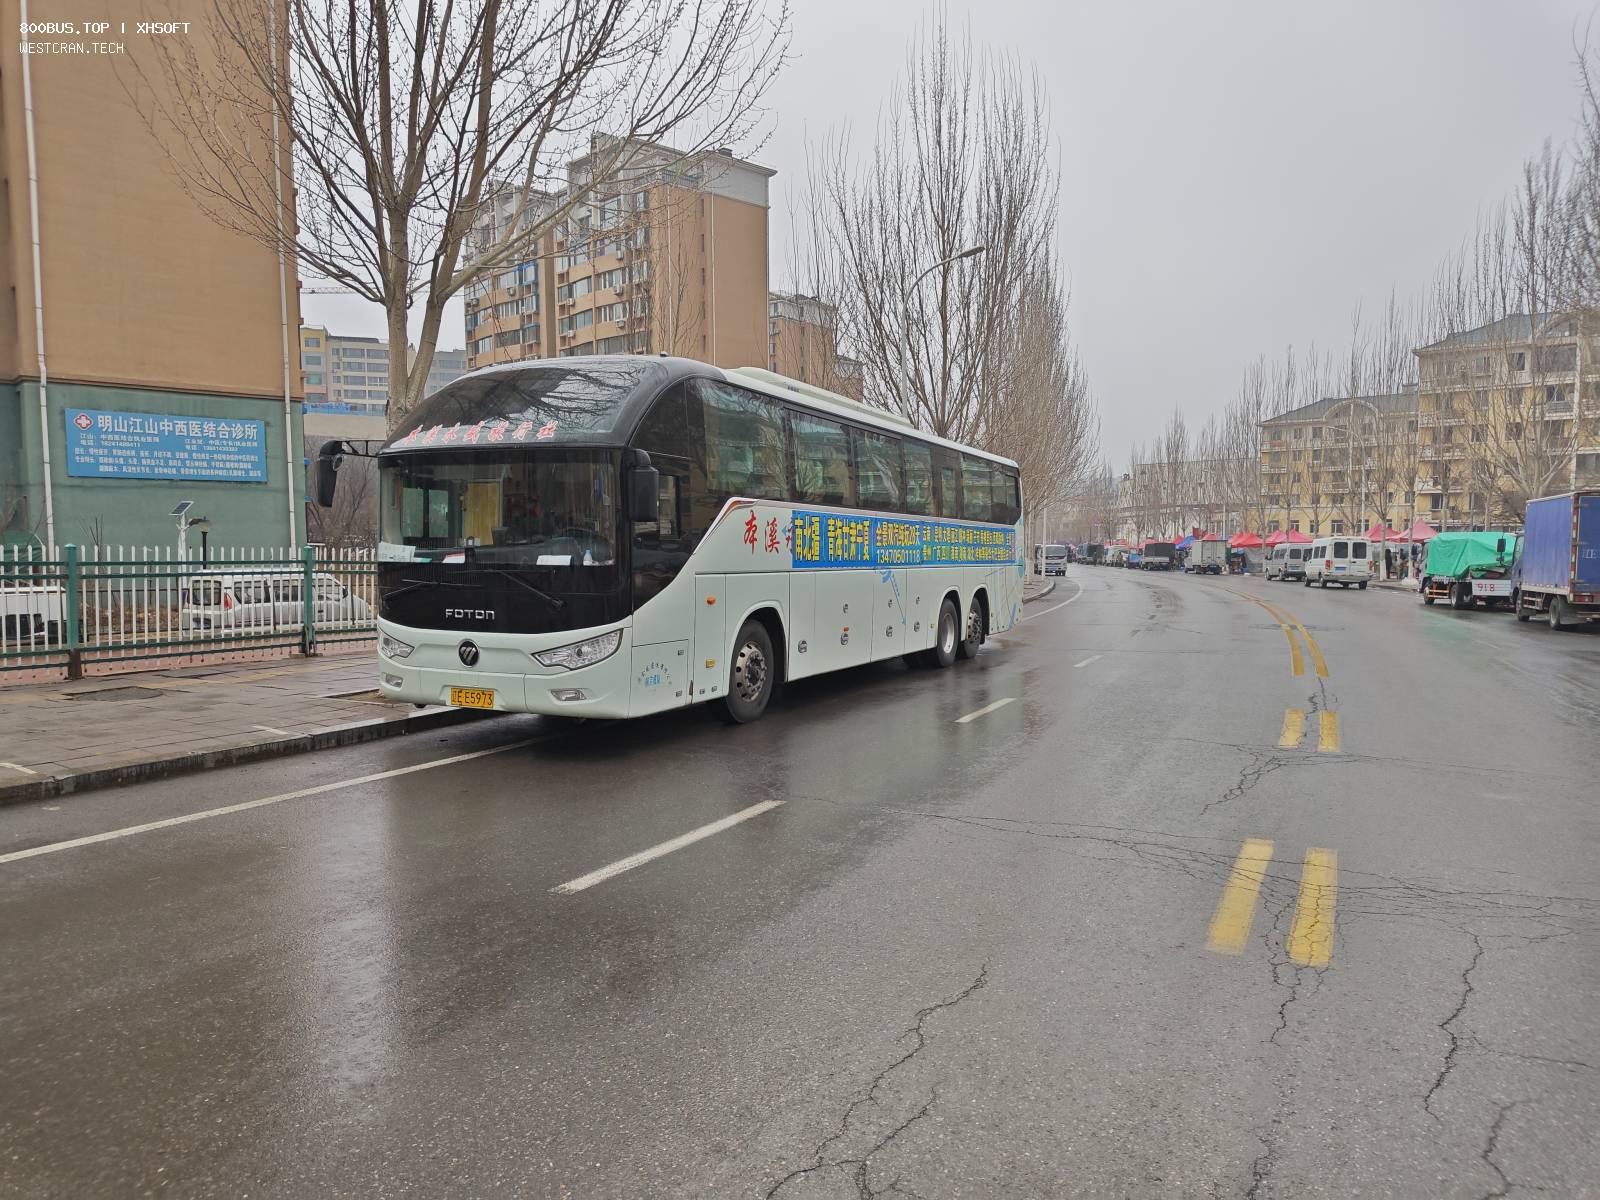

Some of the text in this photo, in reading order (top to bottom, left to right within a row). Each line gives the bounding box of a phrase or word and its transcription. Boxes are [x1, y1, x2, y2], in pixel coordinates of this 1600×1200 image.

[97, 415, 257, 440] 明山江山中西医结合诊所
[794, 515, 821, 561] 南北疆
[828, 518, 870, 562] 青海甘肃宁夏
[445, 608, 495, 620] FOTON
